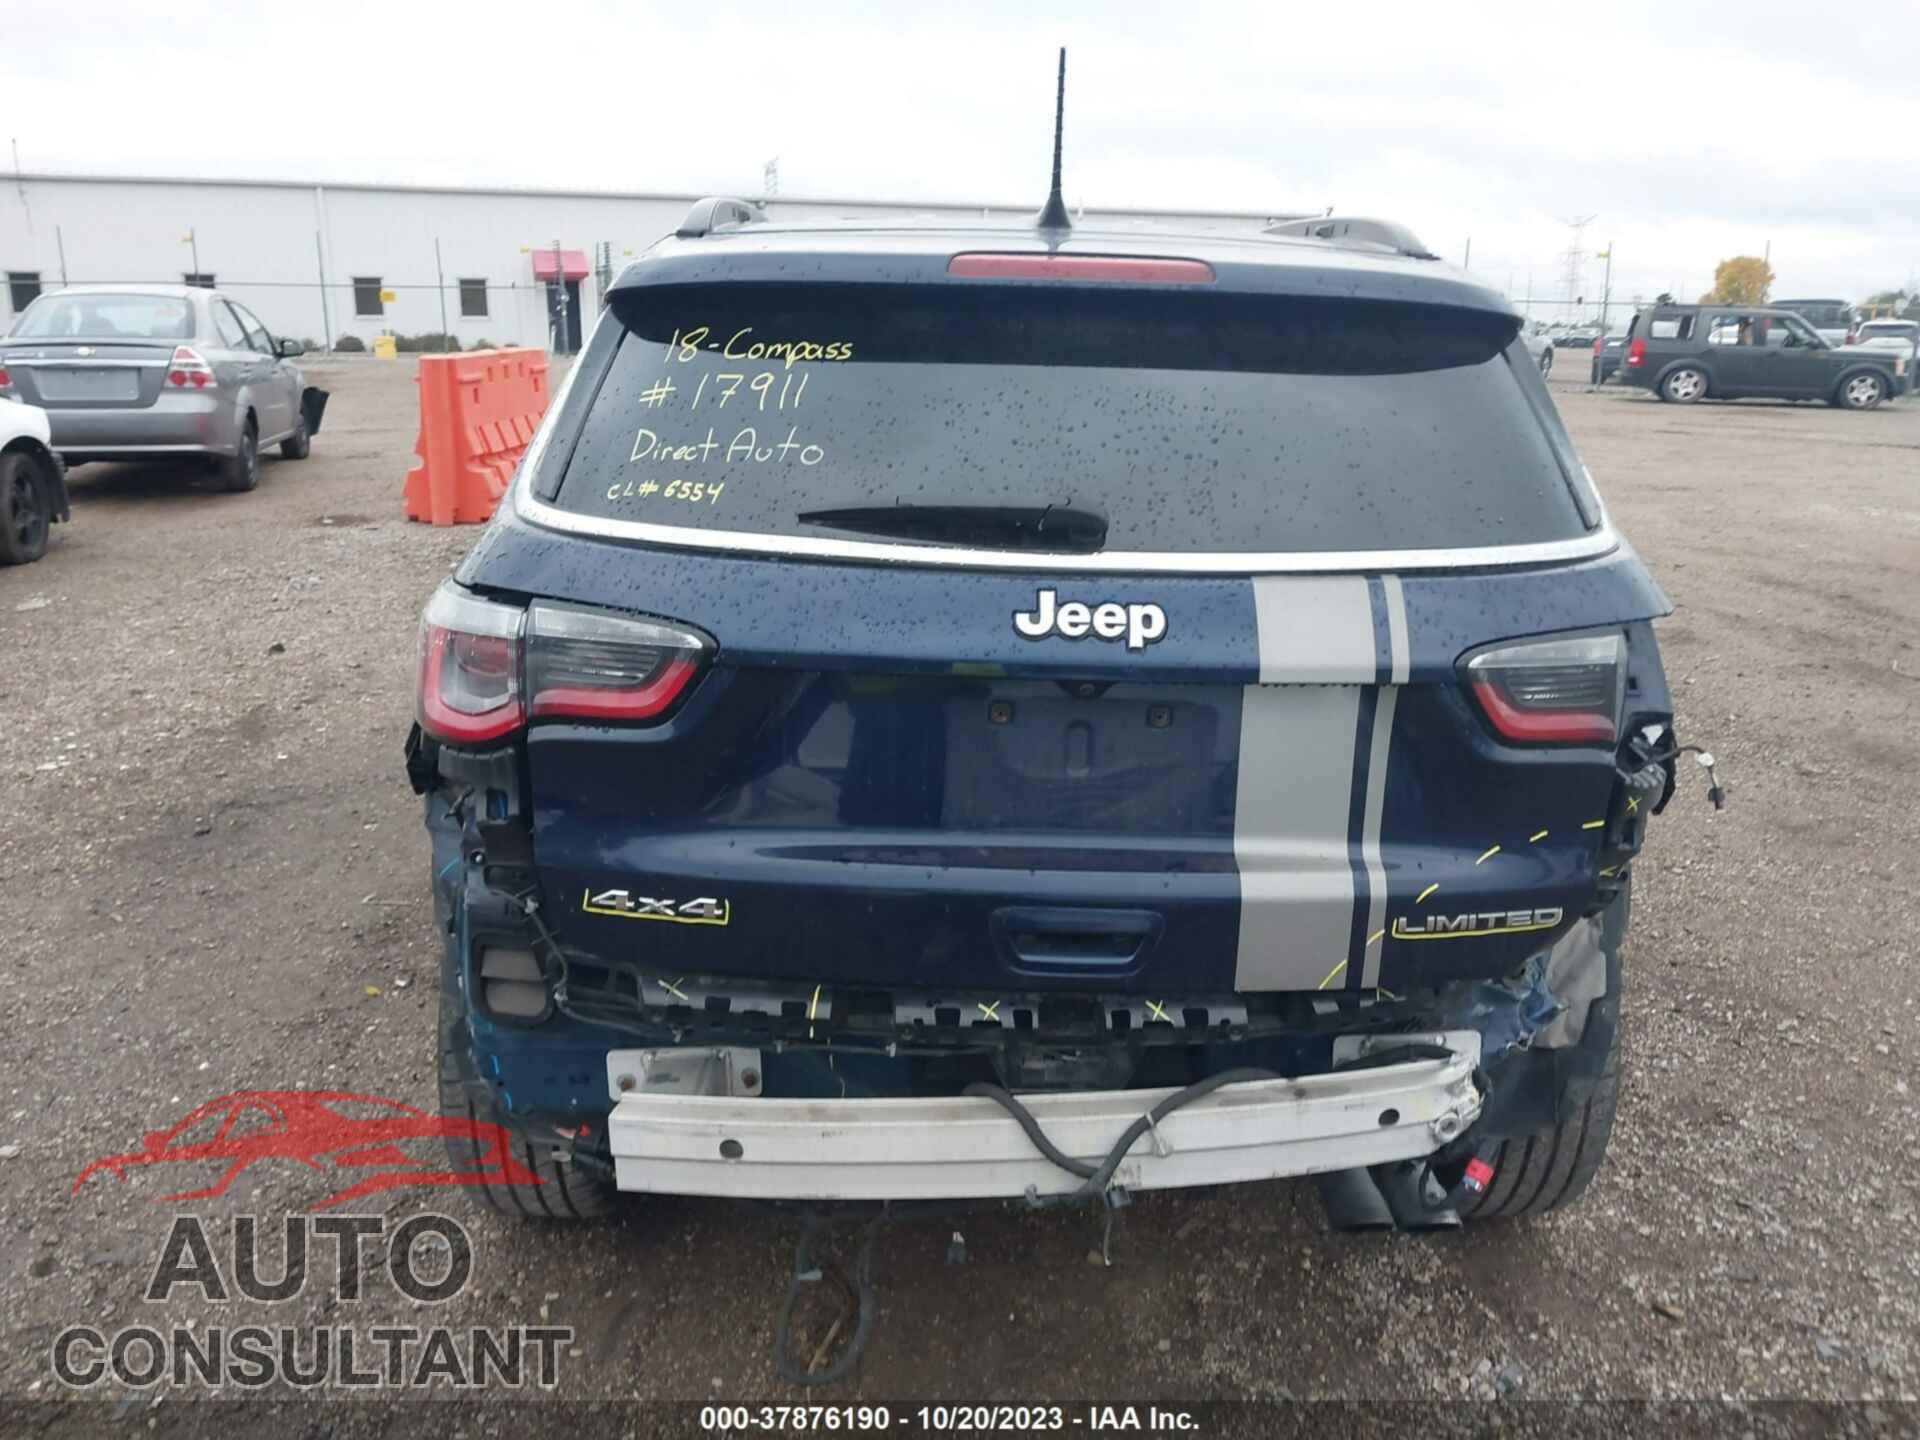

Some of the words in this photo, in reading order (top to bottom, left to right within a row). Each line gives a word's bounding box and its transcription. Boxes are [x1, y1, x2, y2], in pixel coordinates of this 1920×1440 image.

[630, 427, 719, 463] Direct
[726, 426, 824, 465] Auto
[1013, 588, 1168, 650] Jeep
[1399, 907, 1563, 933] LIMITED
